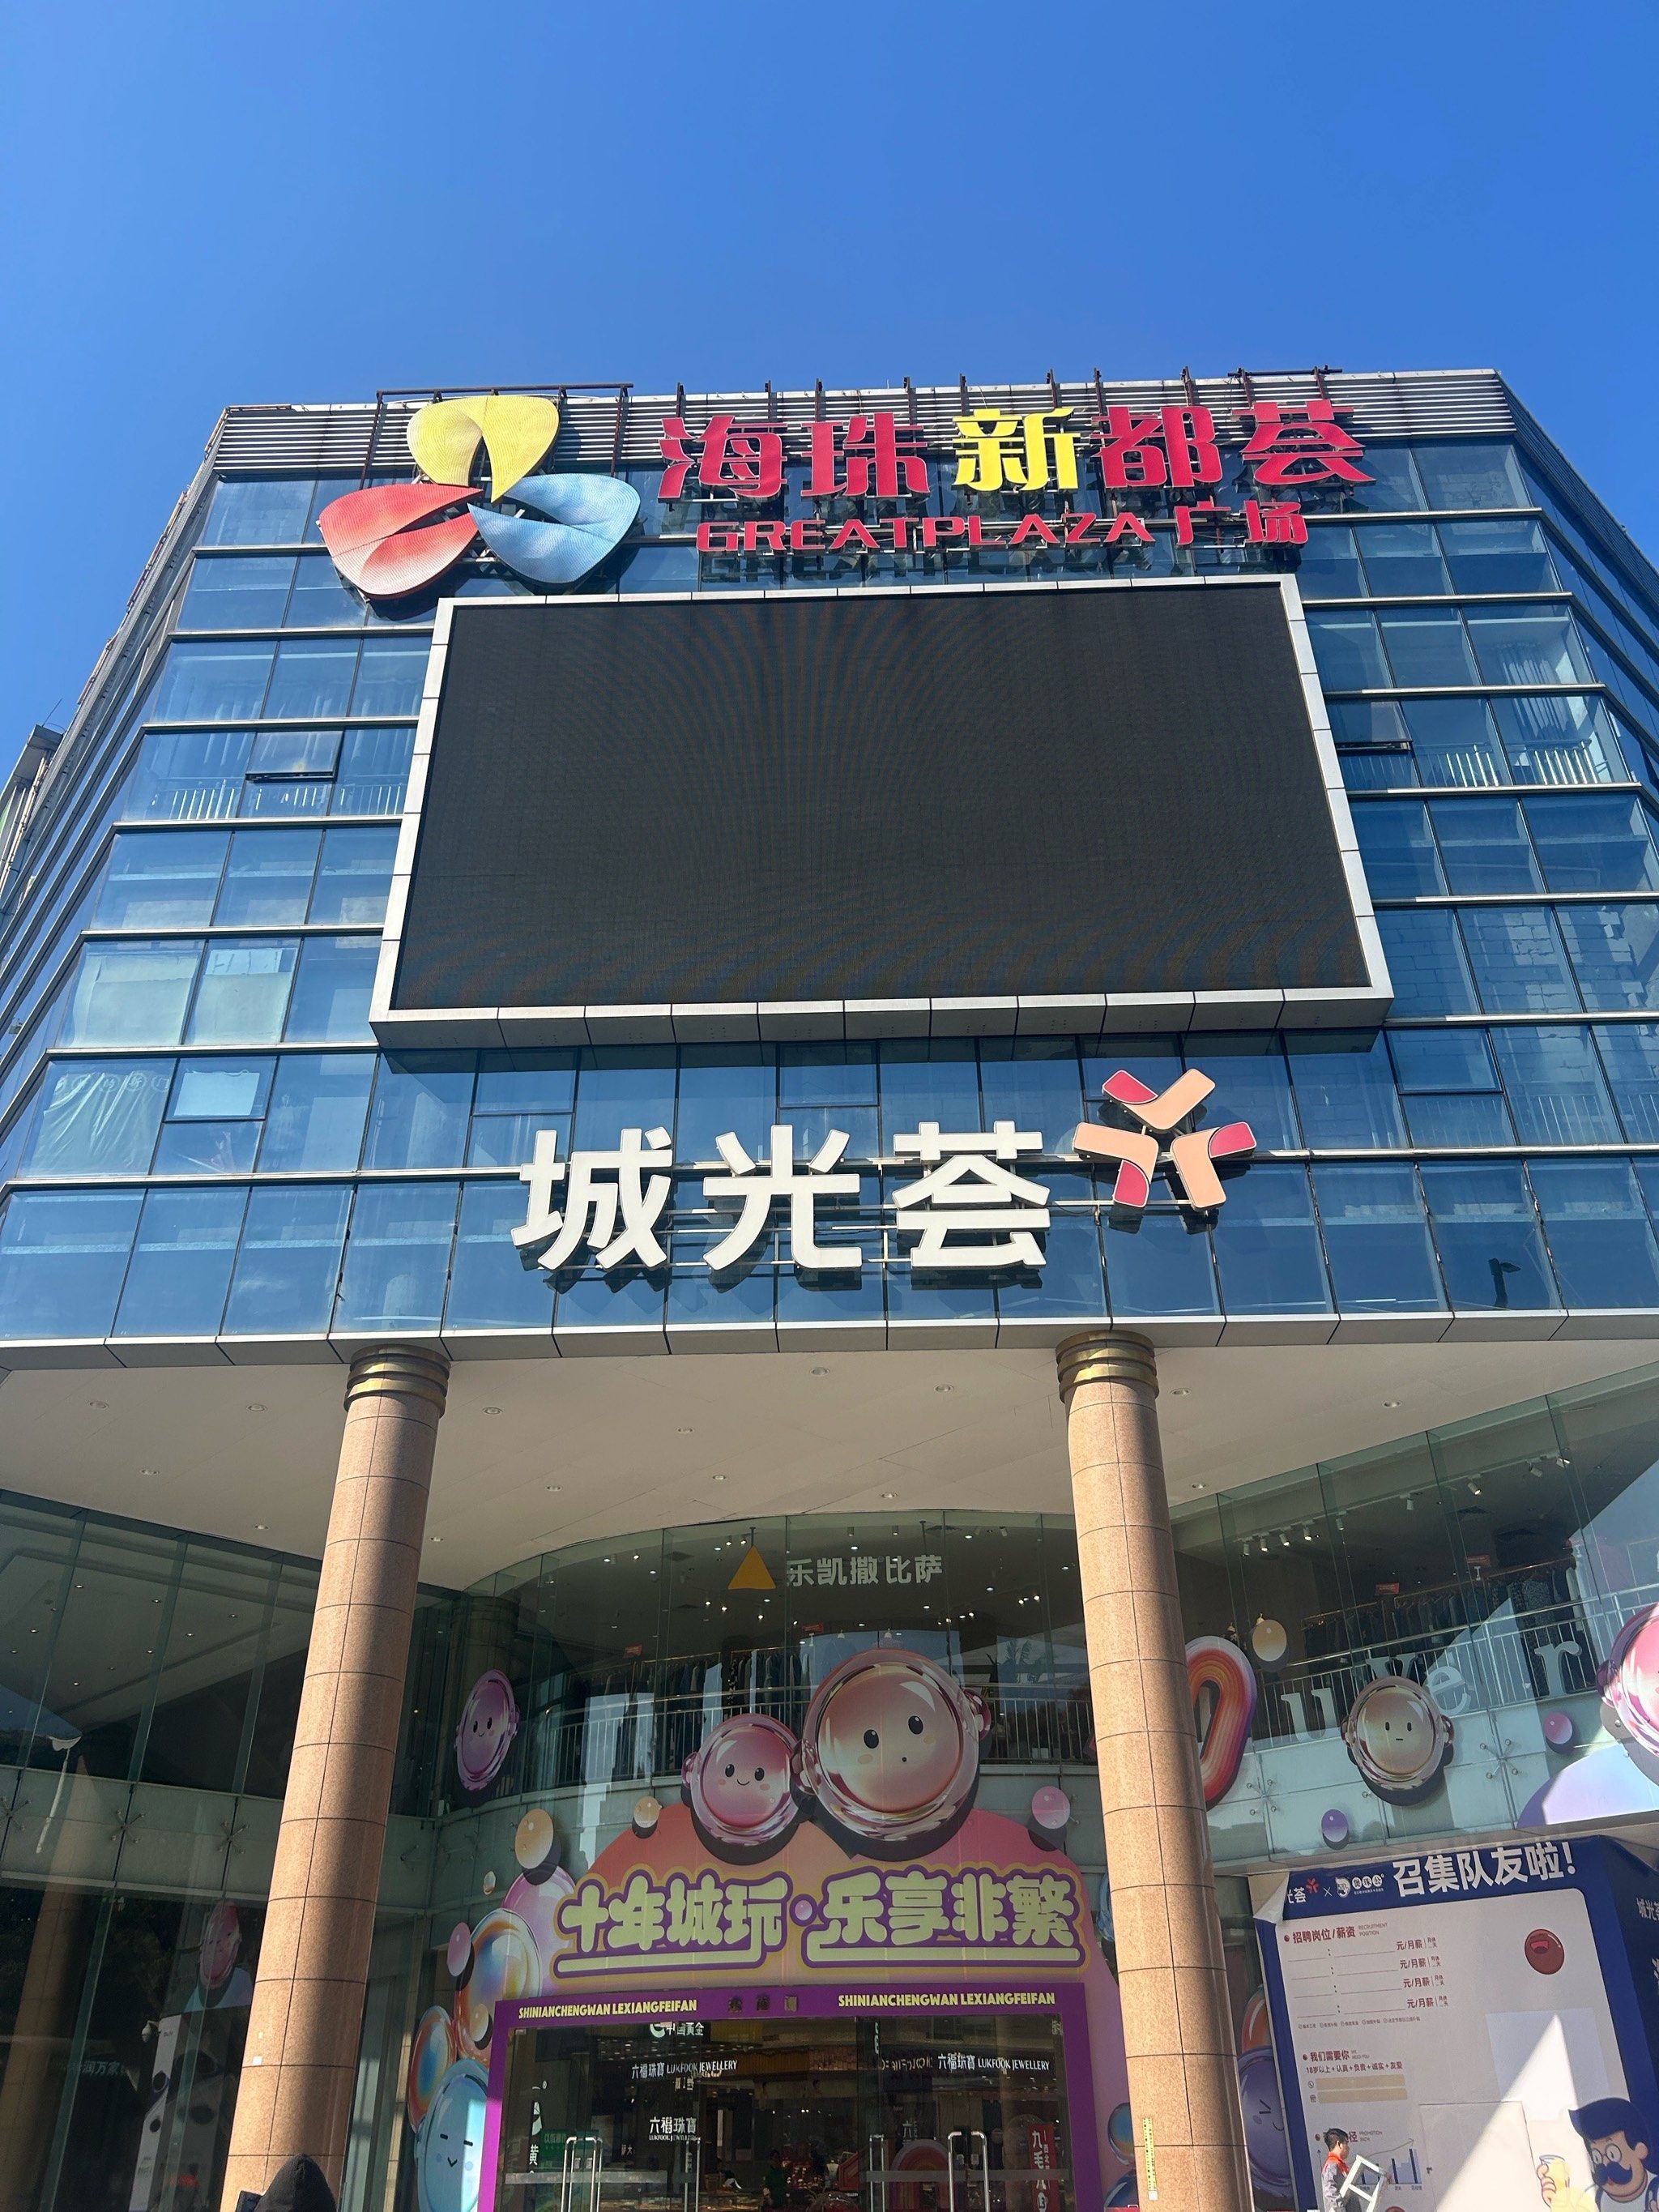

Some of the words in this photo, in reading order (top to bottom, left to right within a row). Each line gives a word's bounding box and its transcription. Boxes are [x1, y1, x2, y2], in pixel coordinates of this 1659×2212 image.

[658, 399, 1376, 499] 海珠新都荟
[697, 512, 1156, 553] GREATPLAZA
[1174, 500, 1308, 544] 广场
[510, 1121, 1051, 1271] 城光荟
[786, 1554, 943, 1586] 乐凯撒比萨
[1293, 1926, 1356, 1944] 招聘岗位/薪资
[518, 2003, 610, 2019] SHINIANCHENGWAN
[612, 1999, 697, 2016] LEXIANGFEIFAN
[838, 1994, 958, 2007] SHINIANCHENGWAN
[961, 1992, 1056, 2005] LEXIANGFEIFAN
[1012, 2059, 1050, 2071] JEWELLERY
[1310, 2049, 1350, 2062] 我们需要你
[699, 2060, 739, 2073] JEWELLERY
